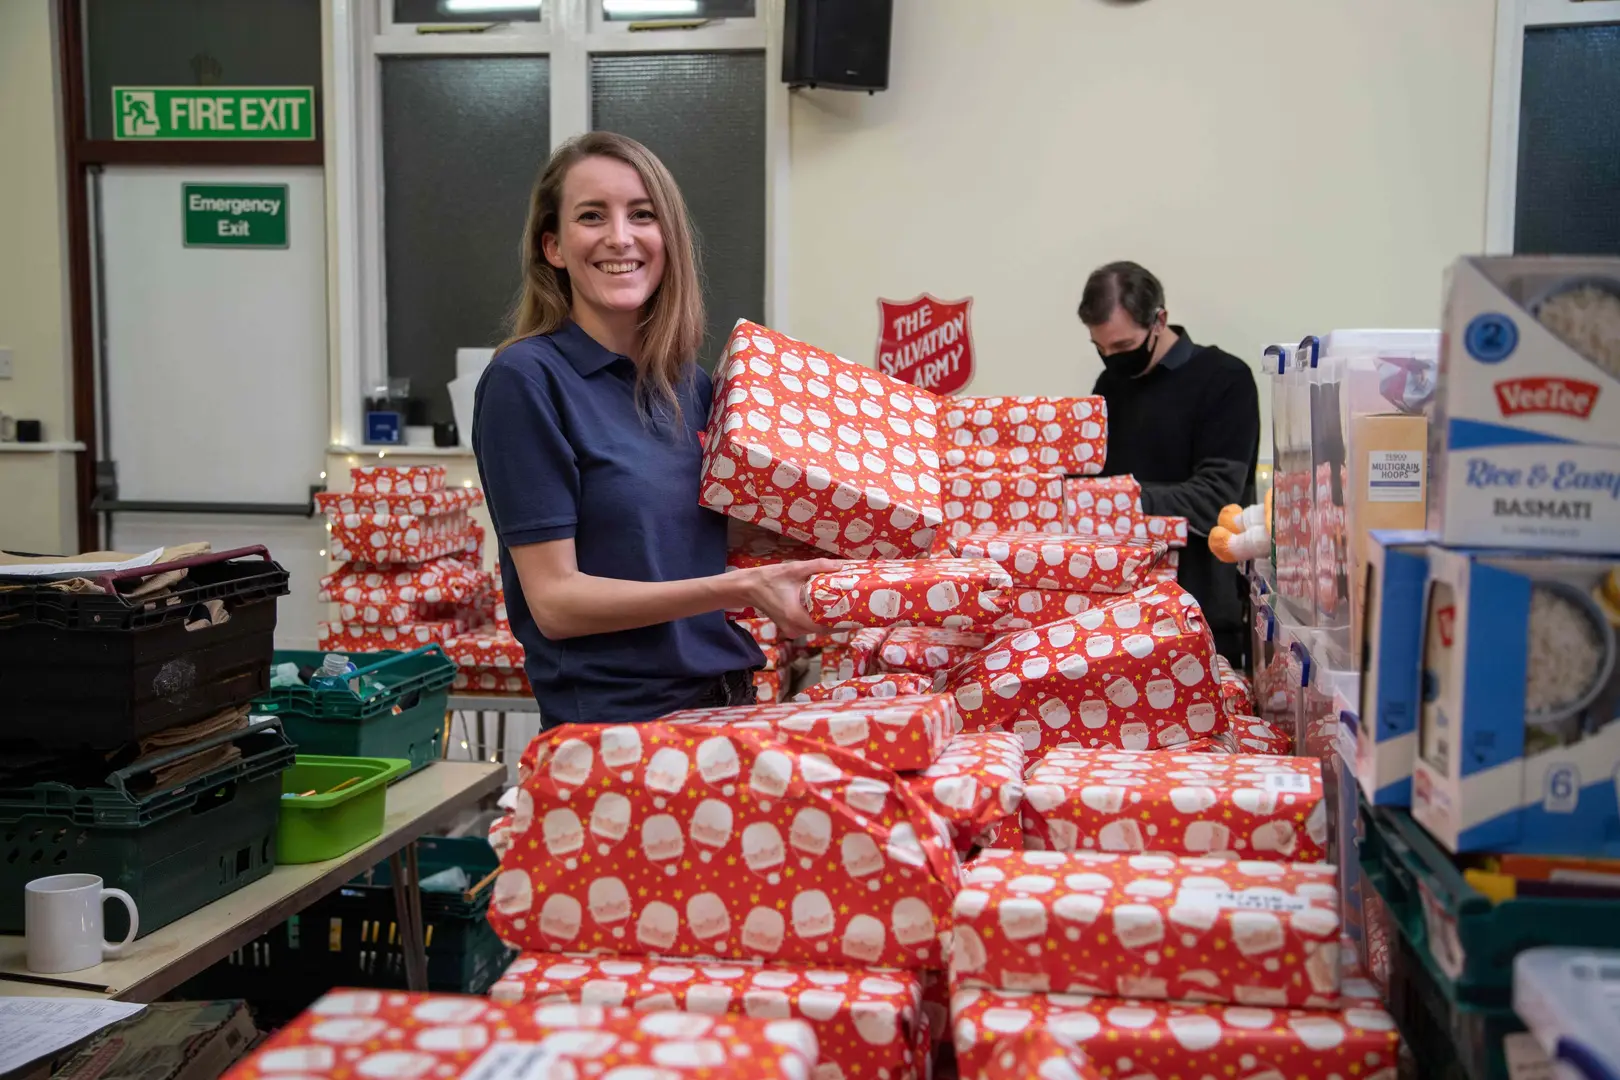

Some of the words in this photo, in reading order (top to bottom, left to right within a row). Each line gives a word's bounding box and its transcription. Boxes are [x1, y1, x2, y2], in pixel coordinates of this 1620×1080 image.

[170, 97, 235, 130] FIRE
[240, 97, 306, 130] EXIT
[189, 194, 281, 215] Emergency
[217, 219, 250, 236] Exit
[893, 304, 933, 341] THE
[1481, 322, 1503, 347] 2
[881, 311, 964, 376] SALVATION
[914, 343, 964, 388] ARMY
[1501, 382, 1590, 412] VeeTee
[1381, 470, 1409, 479] HOOPS
[1466, 458, 1522, 489] Rice
[1494, 498, 1592, 520] BASMATI
[1552, 769, 1572, 799] 6
